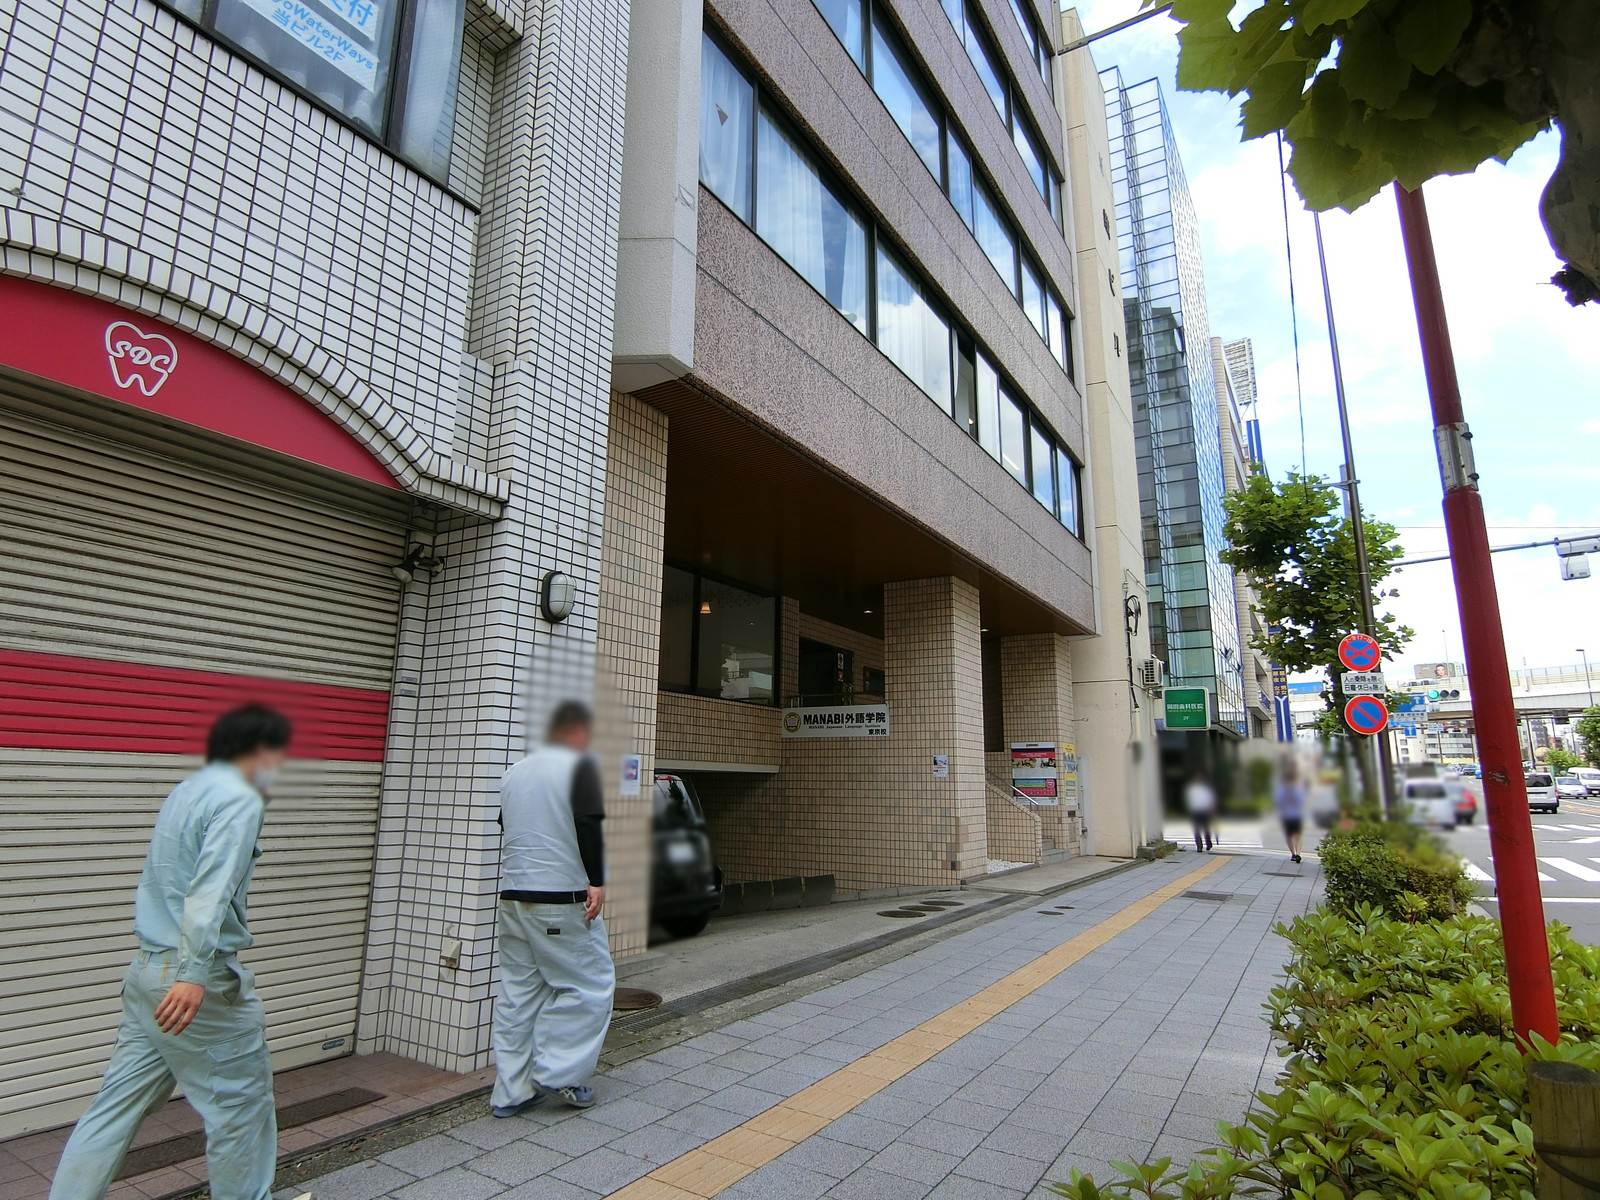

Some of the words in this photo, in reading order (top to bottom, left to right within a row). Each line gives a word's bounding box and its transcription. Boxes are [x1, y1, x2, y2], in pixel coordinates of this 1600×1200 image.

[271, 8, 346, 62] 当ビル2F
[803, 712, 886, 725] MANABI外語学院
[868, 728, 887, 736] 東京校
